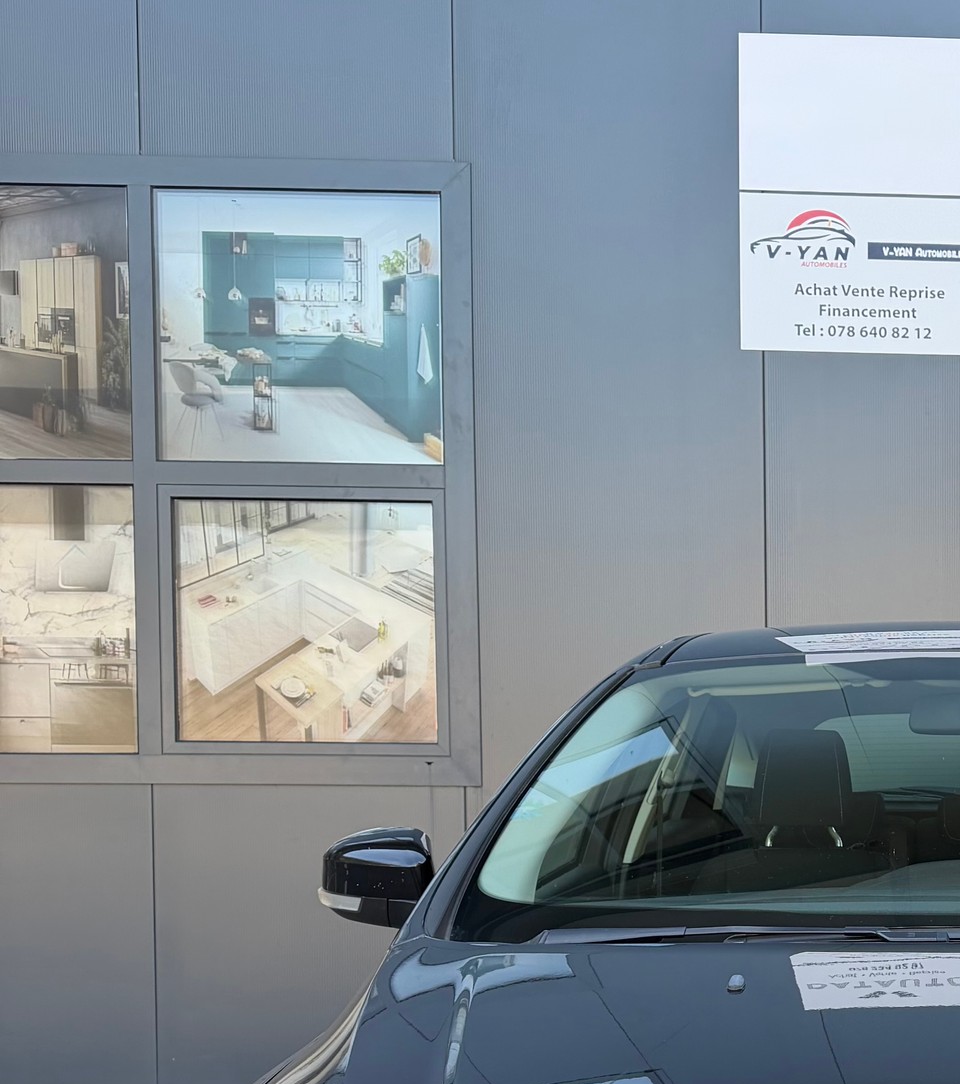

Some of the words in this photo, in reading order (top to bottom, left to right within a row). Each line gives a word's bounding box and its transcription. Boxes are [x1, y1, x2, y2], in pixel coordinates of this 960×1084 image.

[882, 246, 913, 257] V-YAN
[800, 261, 848, 269] AUTOMOBILES
[794, 283, 838, 297] Achat
[841, 285, 885, 298] Vente
[889, 286, 945, 302] Reprise
[819, 304, 917, 319] Financement
[827, 325, 856, 338] 078
[859, 326, 888, 339] 640
[891, 327, 910, 340] 82
[914, 328, 932, 340] 12
